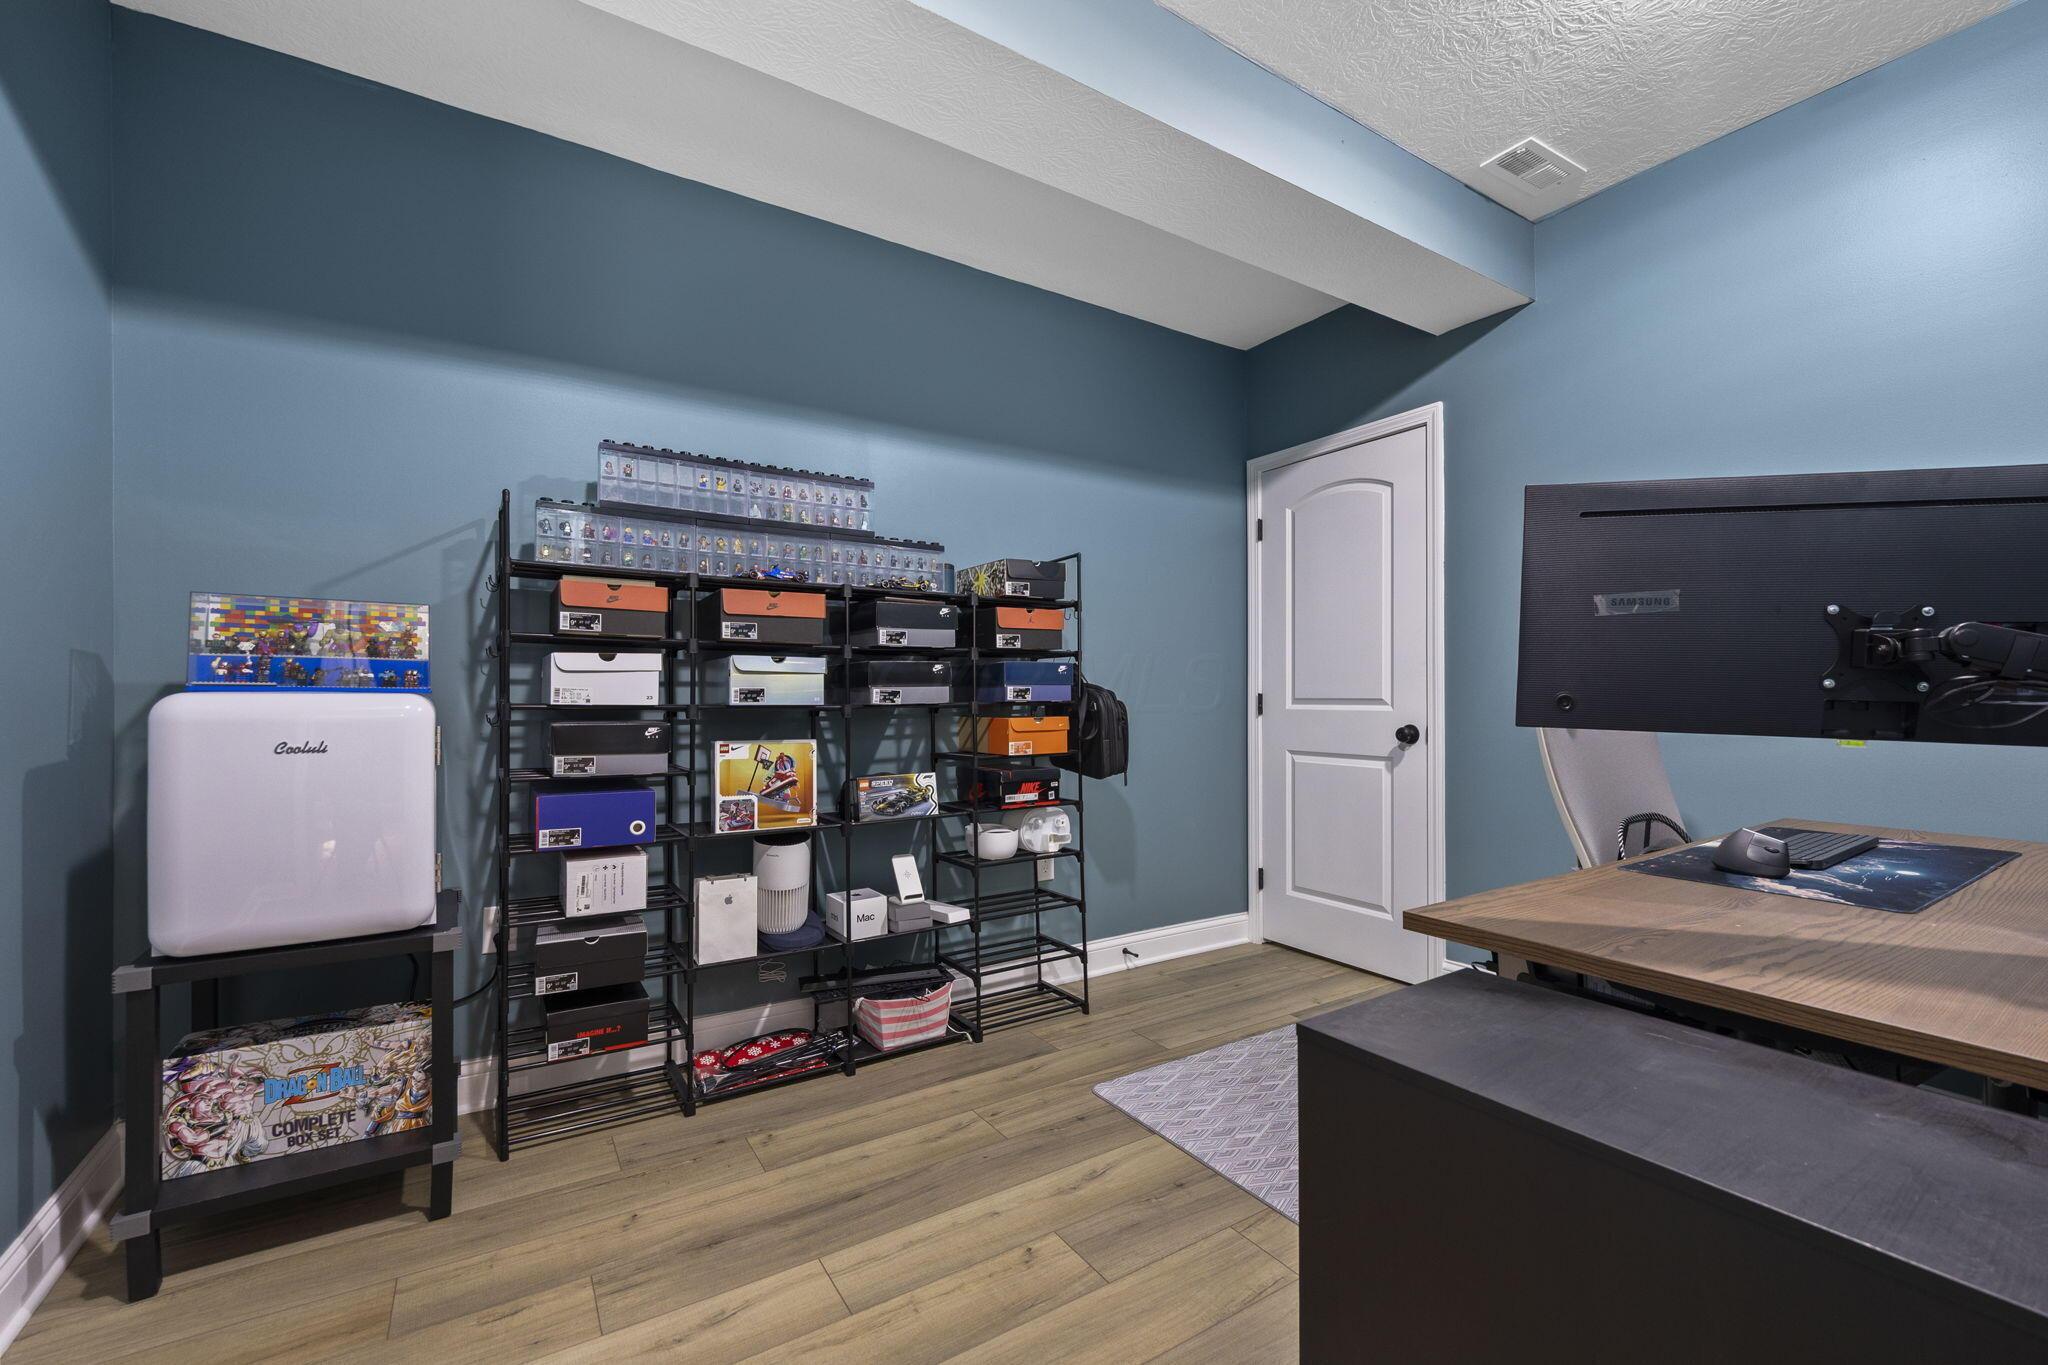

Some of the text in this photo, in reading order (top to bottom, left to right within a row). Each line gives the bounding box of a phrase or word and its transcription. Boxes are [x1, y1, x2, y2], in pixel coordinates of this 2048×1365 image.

[1610, 597, 1671, 607] SAMSUNG
[274, 740, 328, 755] Cooluli
[1020, 782, 1041, 793] NIKE
[856, 913, 875, 923] Mac
[576, 1027, 604, 1038] IMAGINE
[329, 1065, 367, 1091] BALL
[271, 1110, 357, 1138] COMPLETE
[287, 1127, 342, 1148] BOX SET
